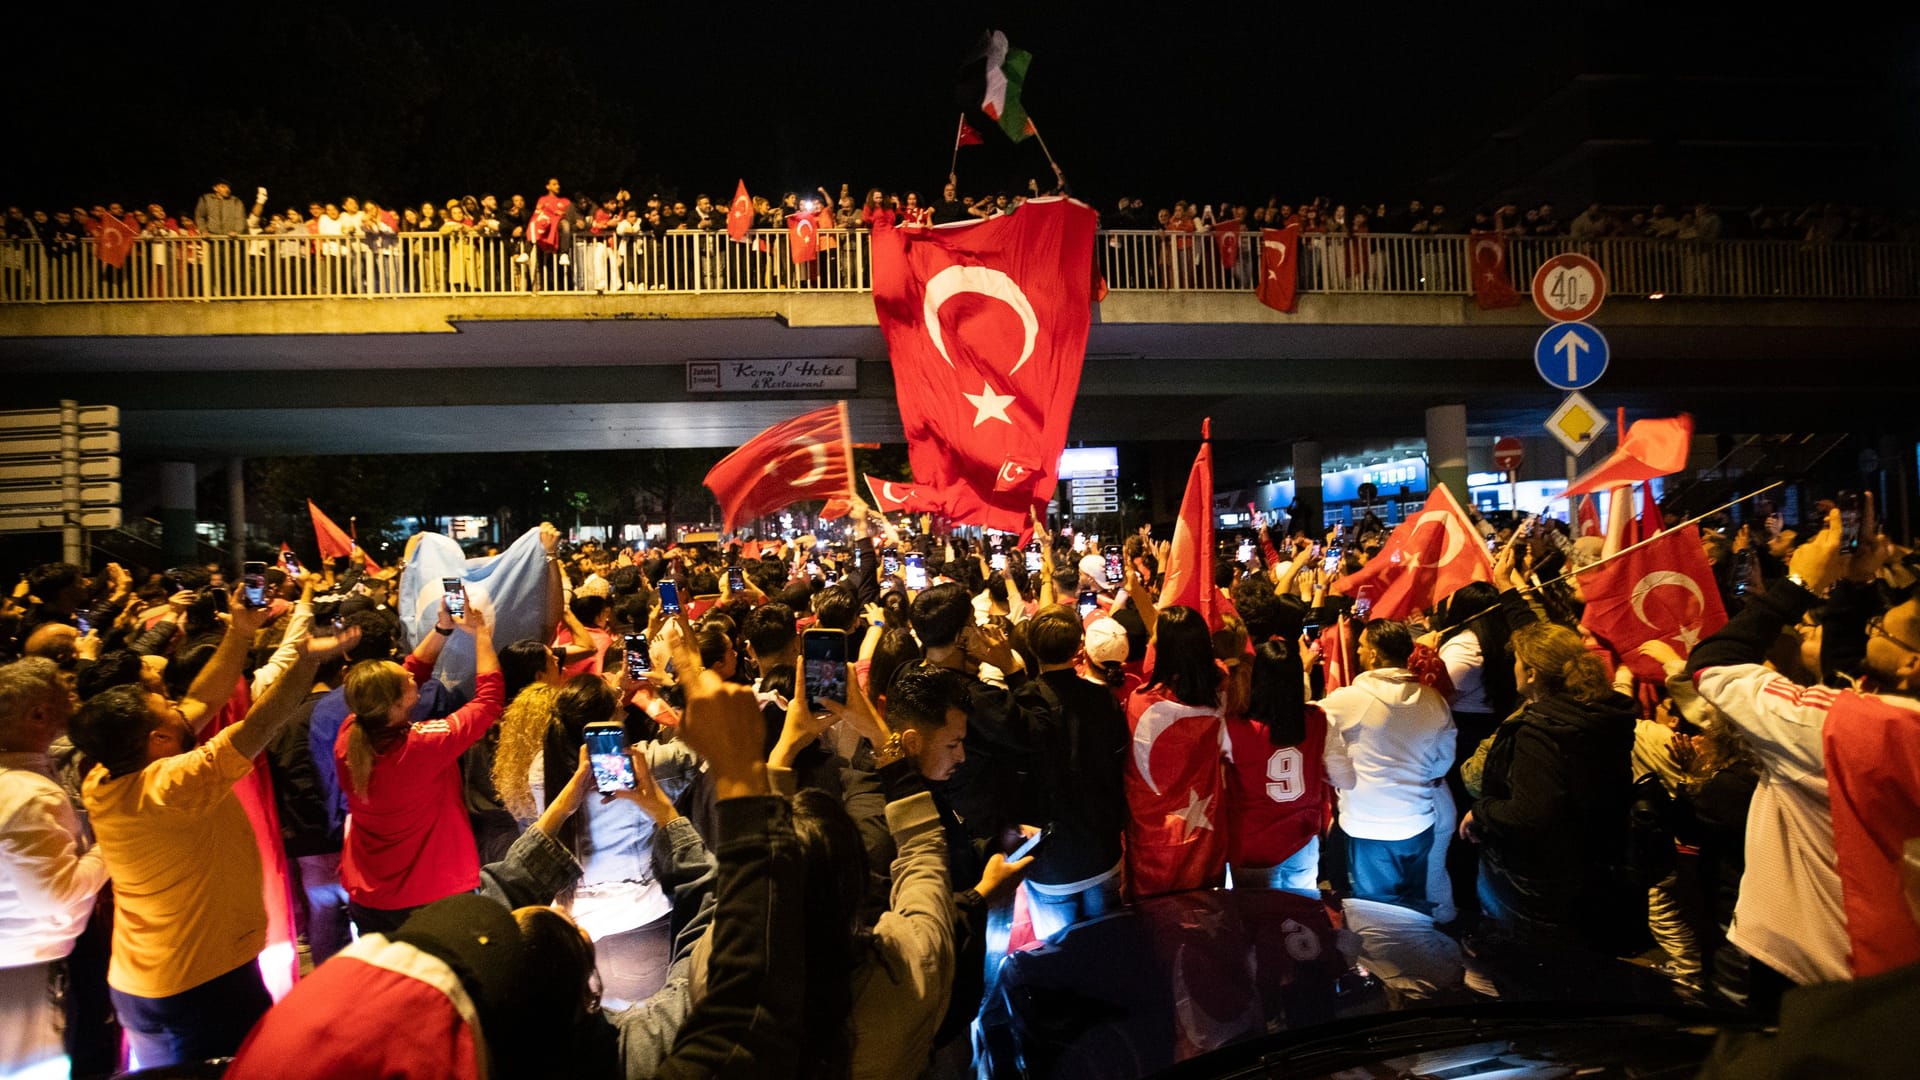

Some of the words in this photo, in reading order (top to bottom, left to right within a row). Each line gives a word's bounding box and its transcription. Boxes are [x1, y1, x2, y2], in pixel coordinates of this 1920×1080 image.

[795, 361, 845, 377] Hotel
[761, 377, 825, 388] Restaurant
[1266, 747, 1306, 802] 9
